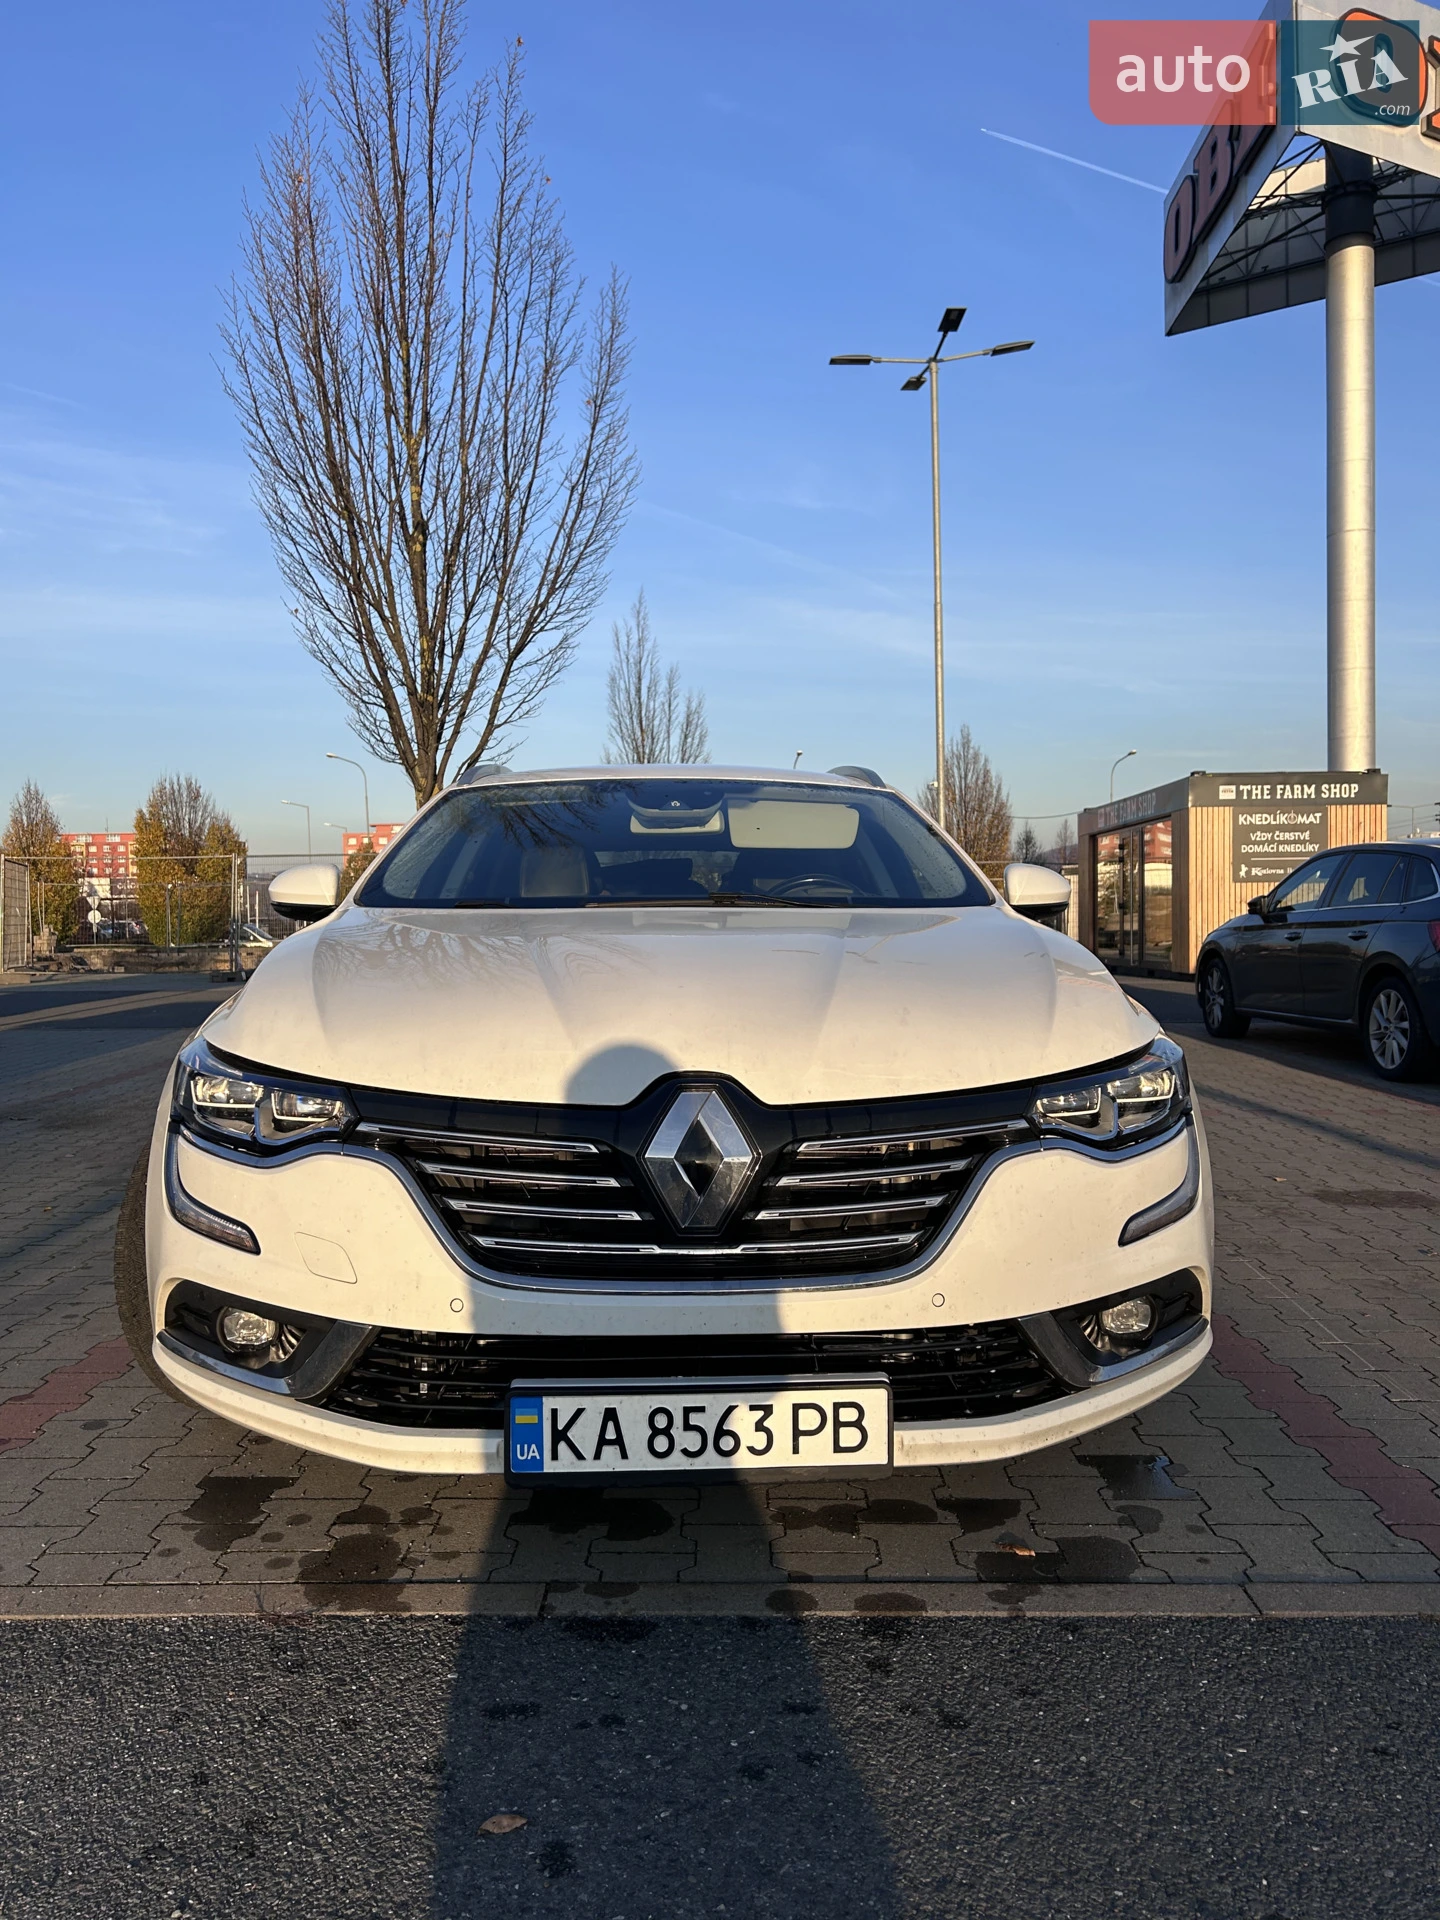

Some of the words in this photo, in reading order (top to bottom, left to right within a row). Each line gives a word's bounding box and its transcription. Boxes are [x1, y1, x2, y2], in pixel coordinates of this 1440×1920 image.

[1239, 784, 1271, 800] THE
[1276, 784, 1316, 799] FARM
[1321, 783, 1359, 798] SHOP
[1139, 792, 1157, 817] SHOP
[1238, 809, 1322, 825] KNEDLÍKOMAT
[1250, 830, 1272, 841] VŽDY
[1274, 830, 1310, 841] ČERSTVÉ
[1241, 842, 1277, 853] DOMÁCÍ
[1279, 842, 1320, 852] KNEDLÍKY
[551, 1406, 629, 1461] KA
[647, 1404, 774, 1460] 8563
[792, 1401, 869, 1455] PB
[516, 1443, 541, 1460] UA
